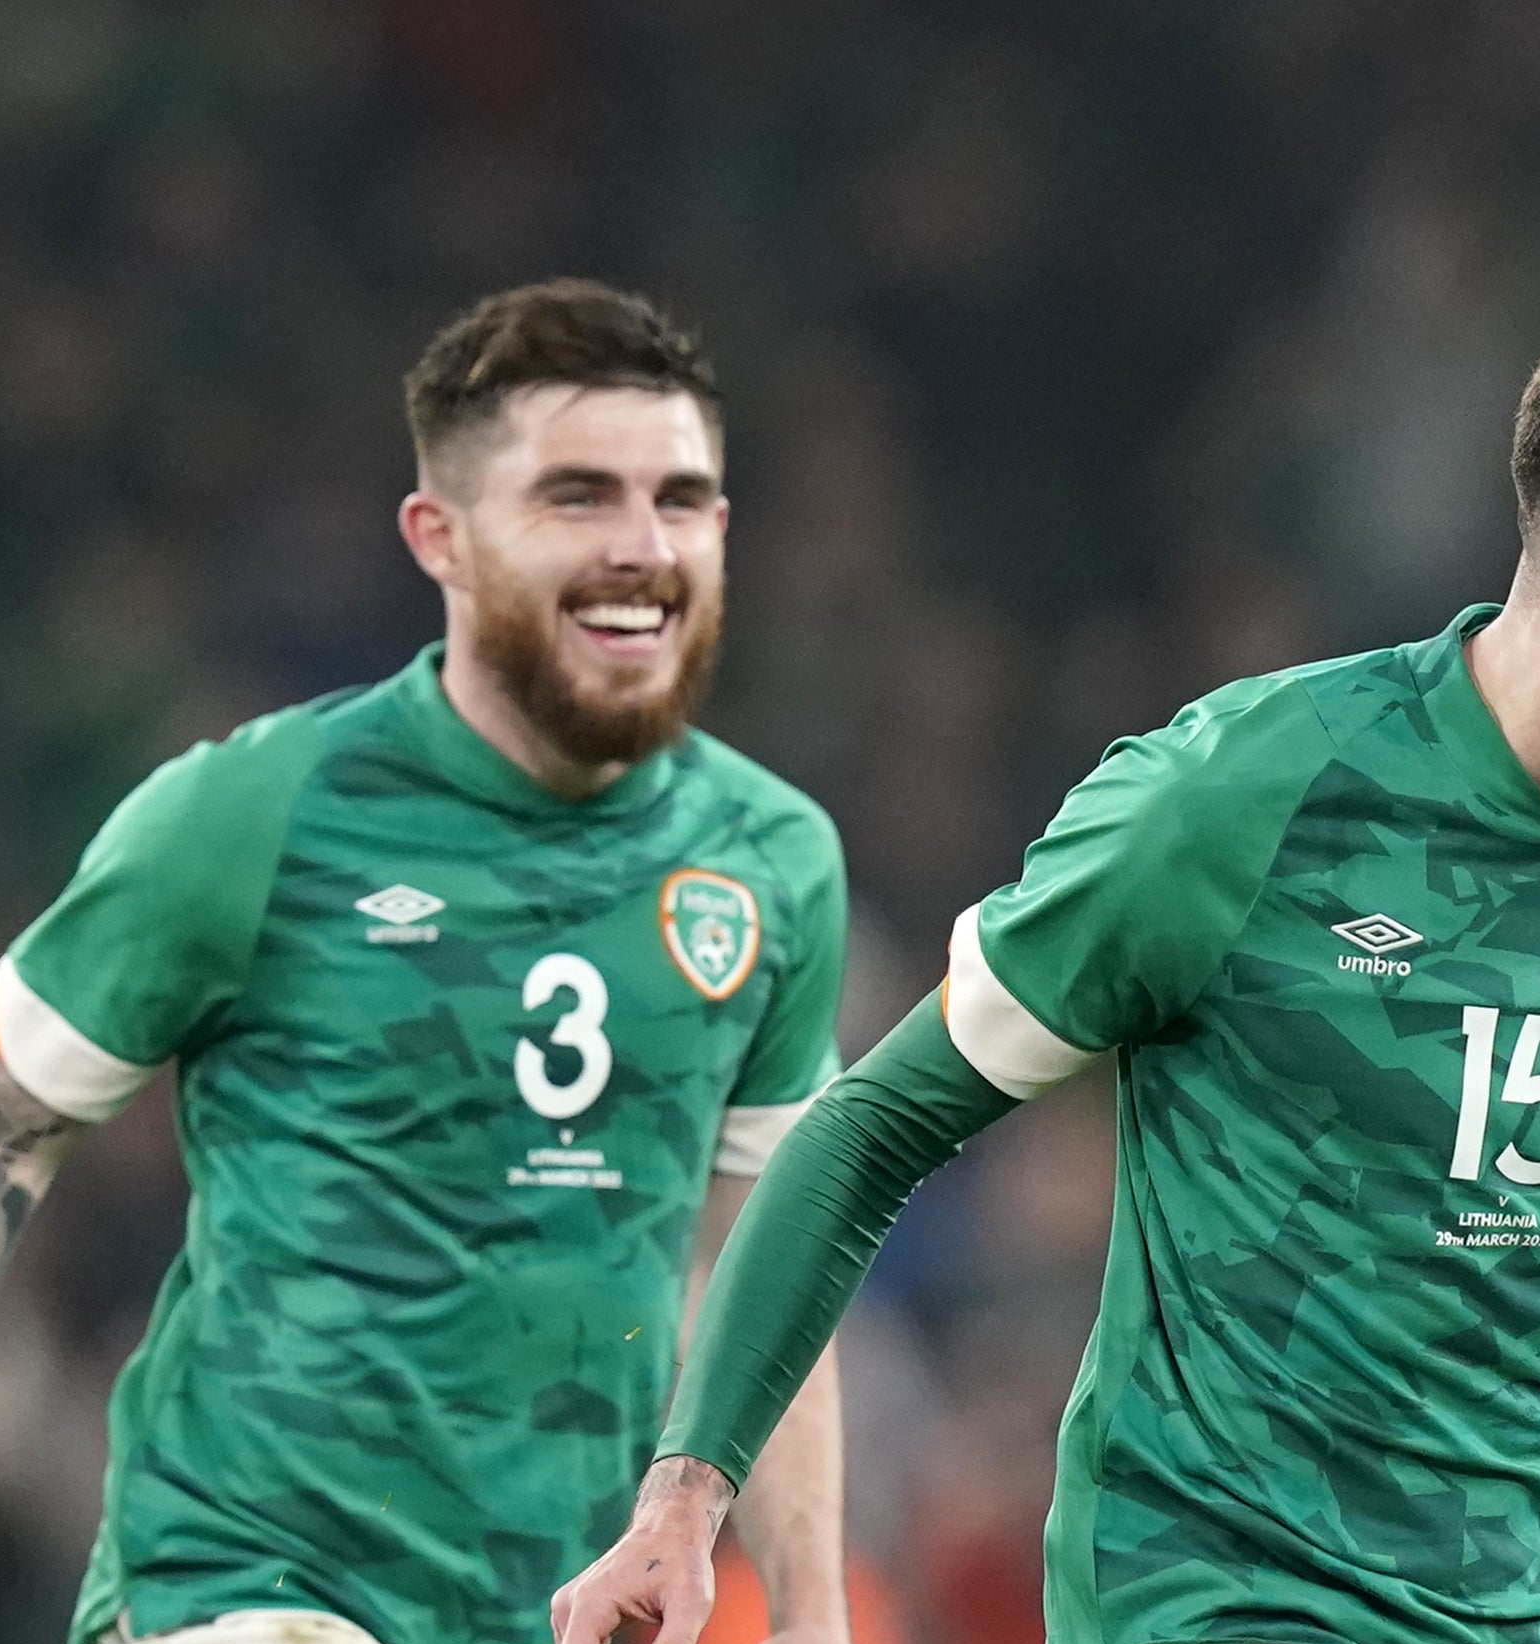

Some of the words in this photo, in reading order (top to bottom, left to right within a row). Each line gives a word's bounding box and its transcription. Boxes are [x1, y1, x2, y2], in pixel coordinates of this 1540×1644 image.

[1337, 954, 1412, 977] umbro
[514, 953, 613, 1119] 3
[1458, 1212, 1538, 1228] LITHUANIA
[1465, 1233, 1520, 1247] MARCH
